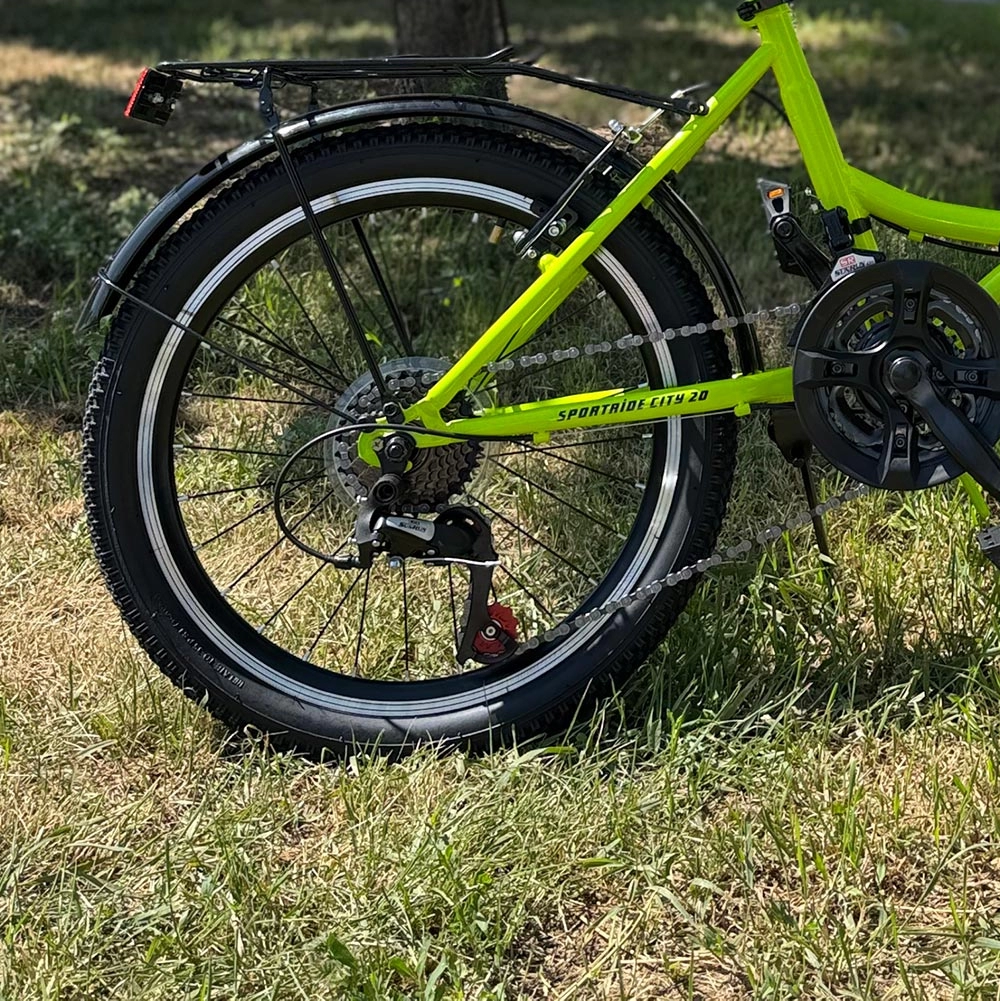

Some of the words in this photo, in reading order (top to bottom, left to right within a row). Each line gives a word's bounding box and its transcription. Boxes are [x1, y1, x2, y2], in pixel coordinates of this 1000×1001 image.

[557, 399, 645, 422] SPORTRIDE
[649, 392, 685, 408] CITY
[687, 389, 710, 403] 20
